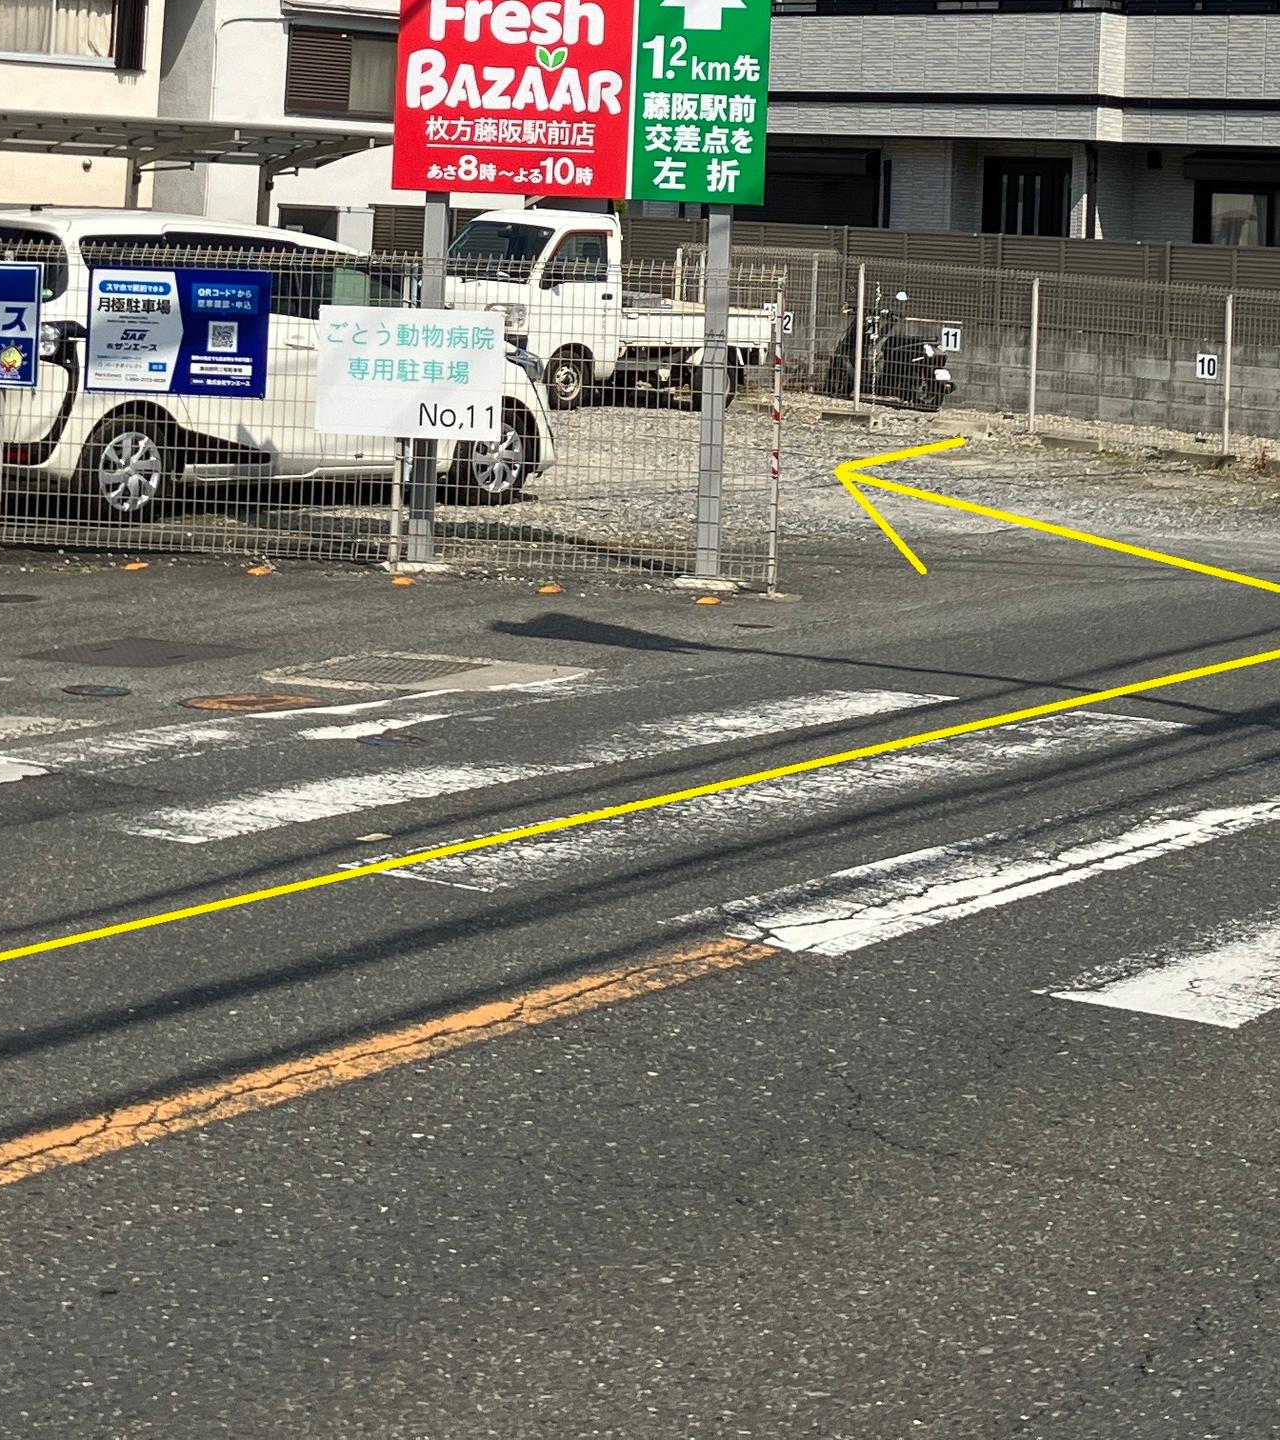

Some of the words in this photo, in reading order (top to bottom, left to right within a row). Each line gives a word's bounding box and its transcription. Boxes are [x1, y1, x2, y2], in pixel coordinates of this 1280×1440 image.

[405, 48, 623, 115] BAZAAR
[642, 92, 757, 123] 藤阪駅前
[425, 116, 596, 148] 枚方藤阪駅前店
[644, 124, 754, 156] 交差点を
[97, 297, 171, 315] 月極駐車場
[327, 321, 495, 351] ごとう動物病院
[943, 330, 958, 349] 11
[347, 358, 470, 385] 専用駐車場
[1198, 357, 1216, 376] 10
